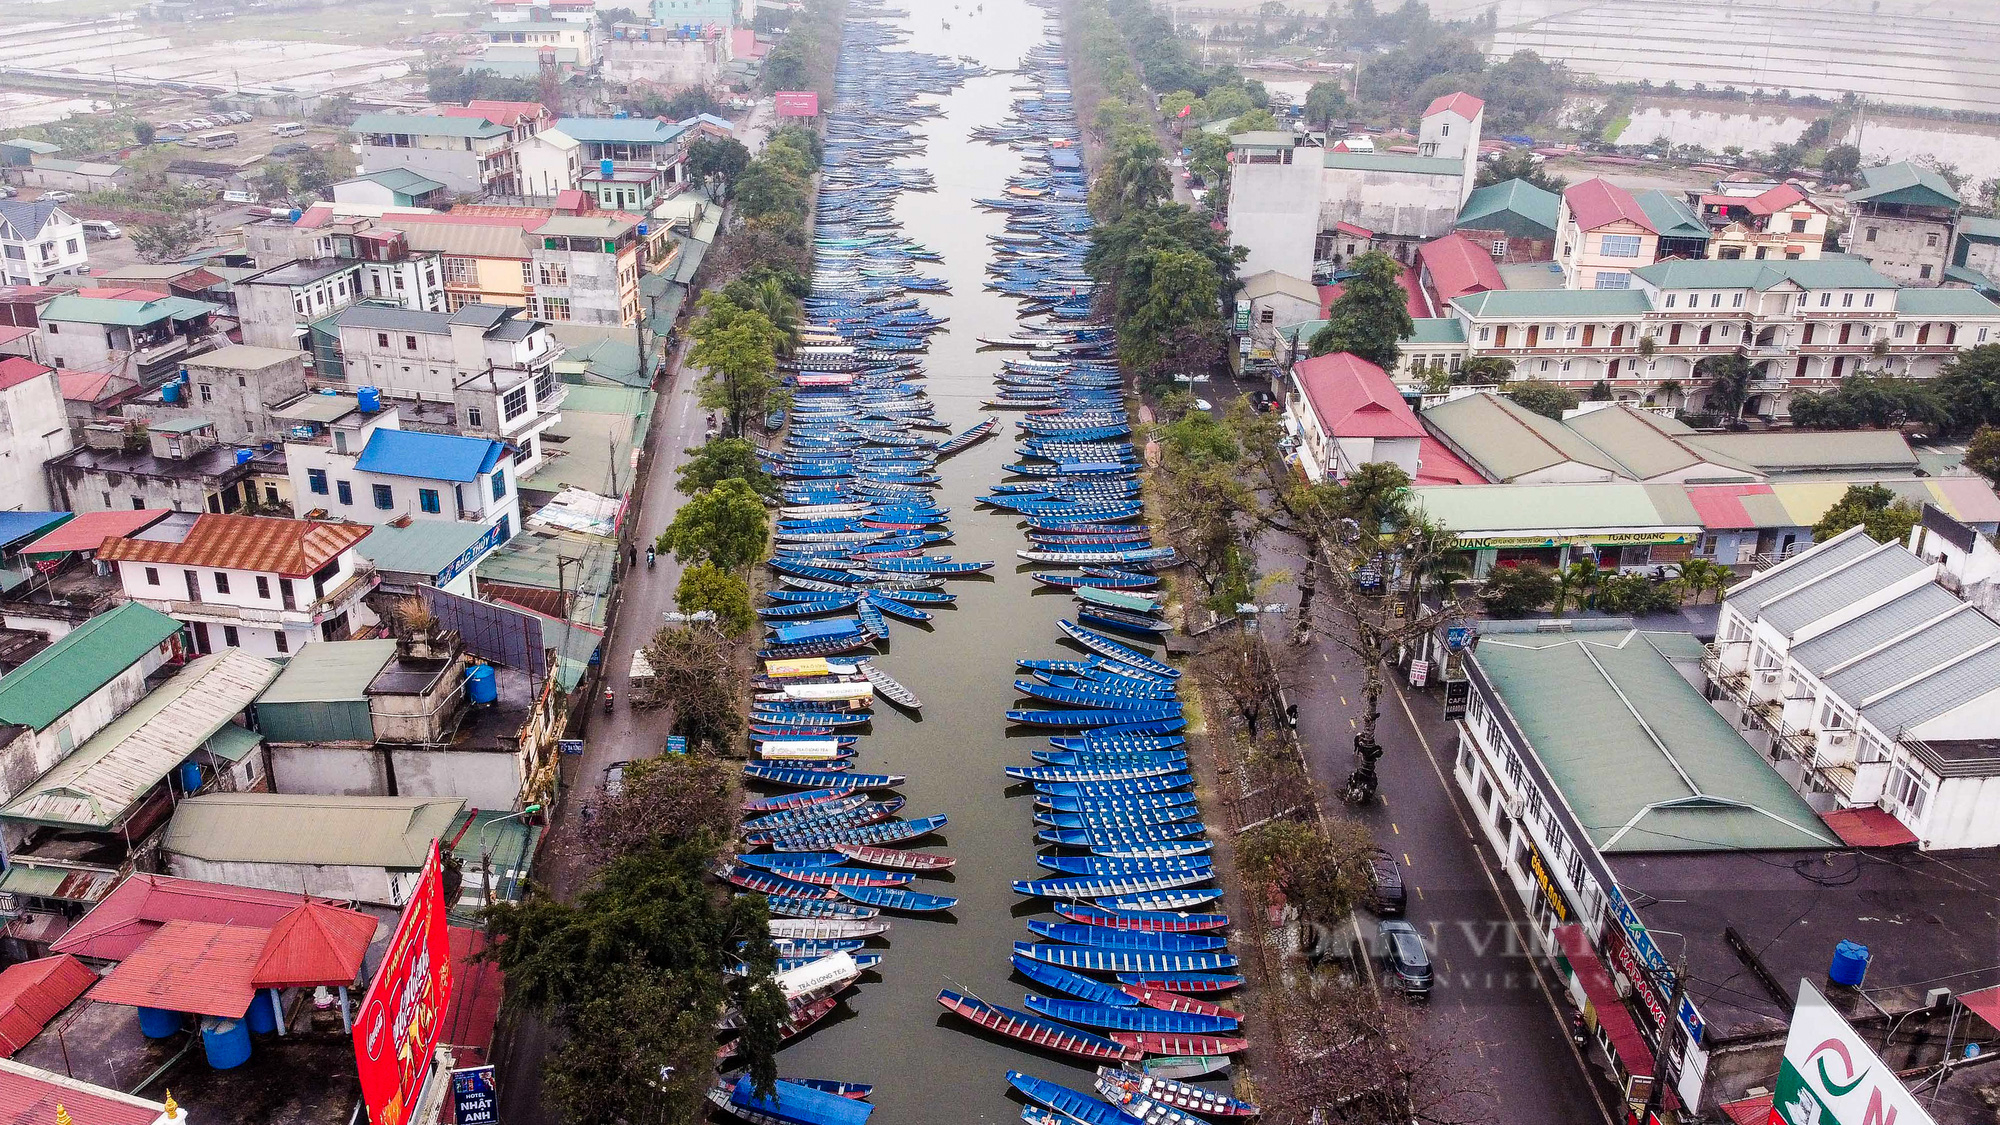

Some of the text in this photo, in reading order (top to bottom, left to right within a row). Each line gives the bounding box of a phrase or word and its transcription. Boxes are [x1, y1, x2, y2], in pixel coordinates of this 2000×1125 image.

[1450, 538, 1491, 548] QUANG
[1633, 533, 1666, 541] QUANG
[1624, 911, 1642, 944] BAR
[816, 972, 833, 983] LONG
[832, 967, 847, 976] TEA
[1619, 947, 1667, 1032] KARAOKE
[460, 1098, 493, 1111] NHẬT
[465, 1111, 491, 1122] ANH
